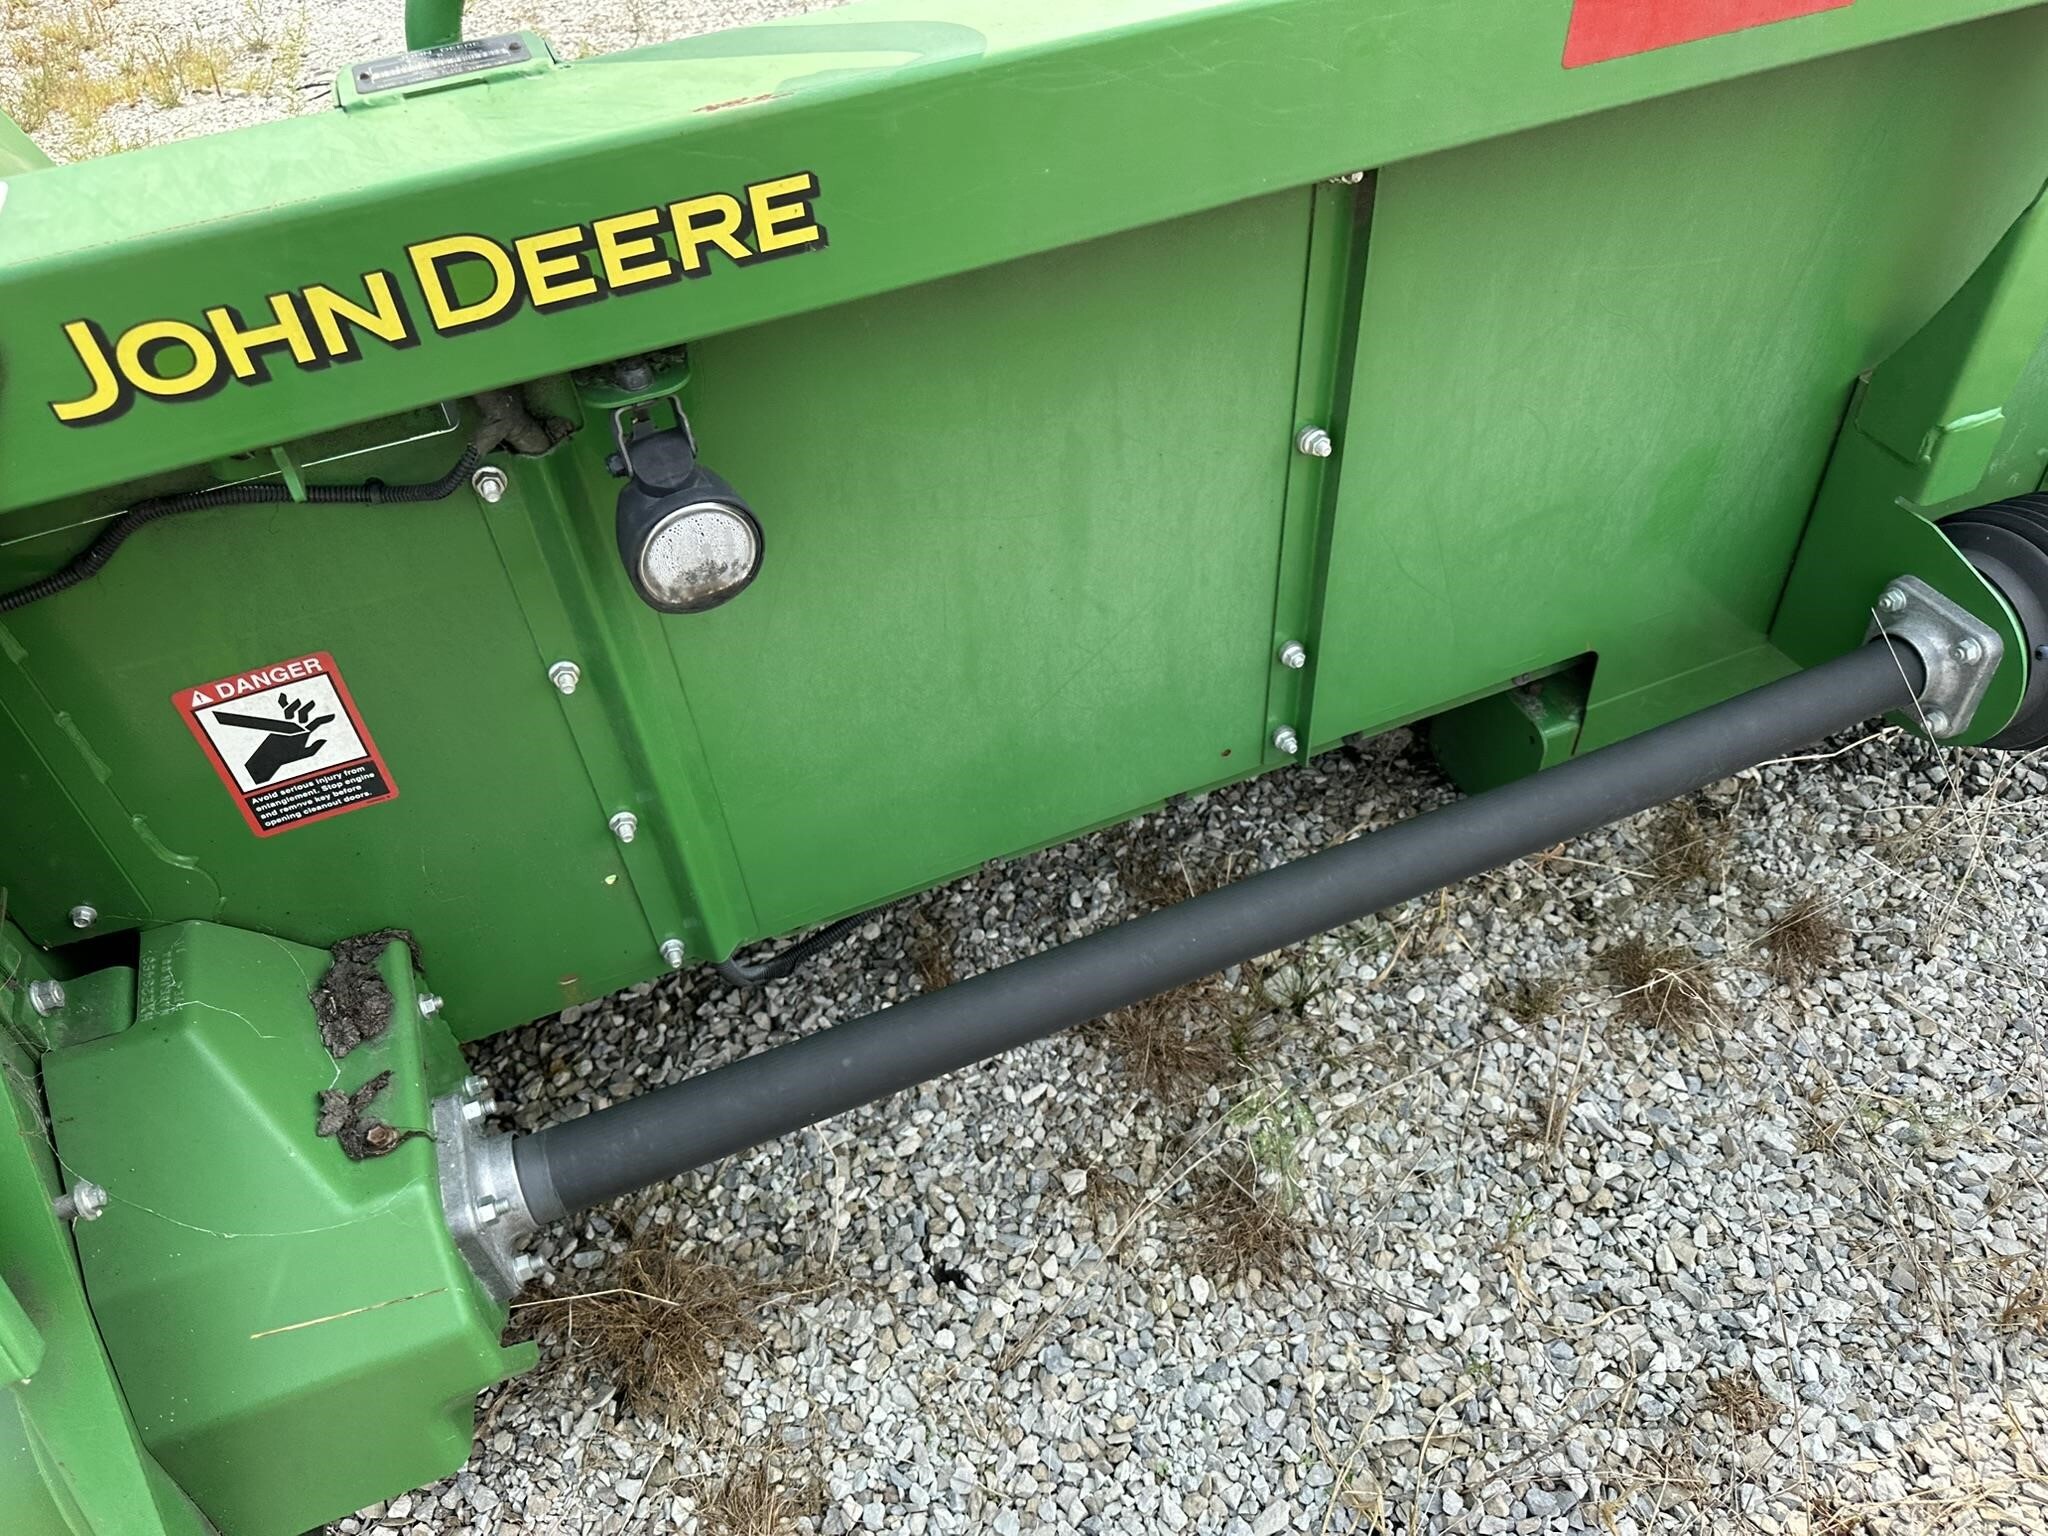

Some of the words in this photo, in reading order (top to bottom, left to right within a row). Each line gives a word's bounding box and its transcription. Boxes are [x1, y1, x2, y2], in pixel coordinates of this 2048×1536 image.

[50, 269, 412, 426] JOHN
[407, 172, 826, 332] DEERE
[215, 658, 322, 699] DANGER
[252, 791, 278, 804] Avoid
[280, 781, 314, 796] serious
[316, 772, 342, 787] injury
[344, 766, 365, 776] from
[256, 789, 319, 812] entanglement.
[322, 781, 343, 792] Stop
[345, 772, 375, 785] engine
[260, 809, 278, 820] and
[280, 799, 313, 814] remove
[315, 792, 331, 805] key
[332, 785, 362, 797] before
[265, 811, 302, 827] opening
[303, 799, 342, 814] cleanout
[344, 791, 372, 803] doors.
